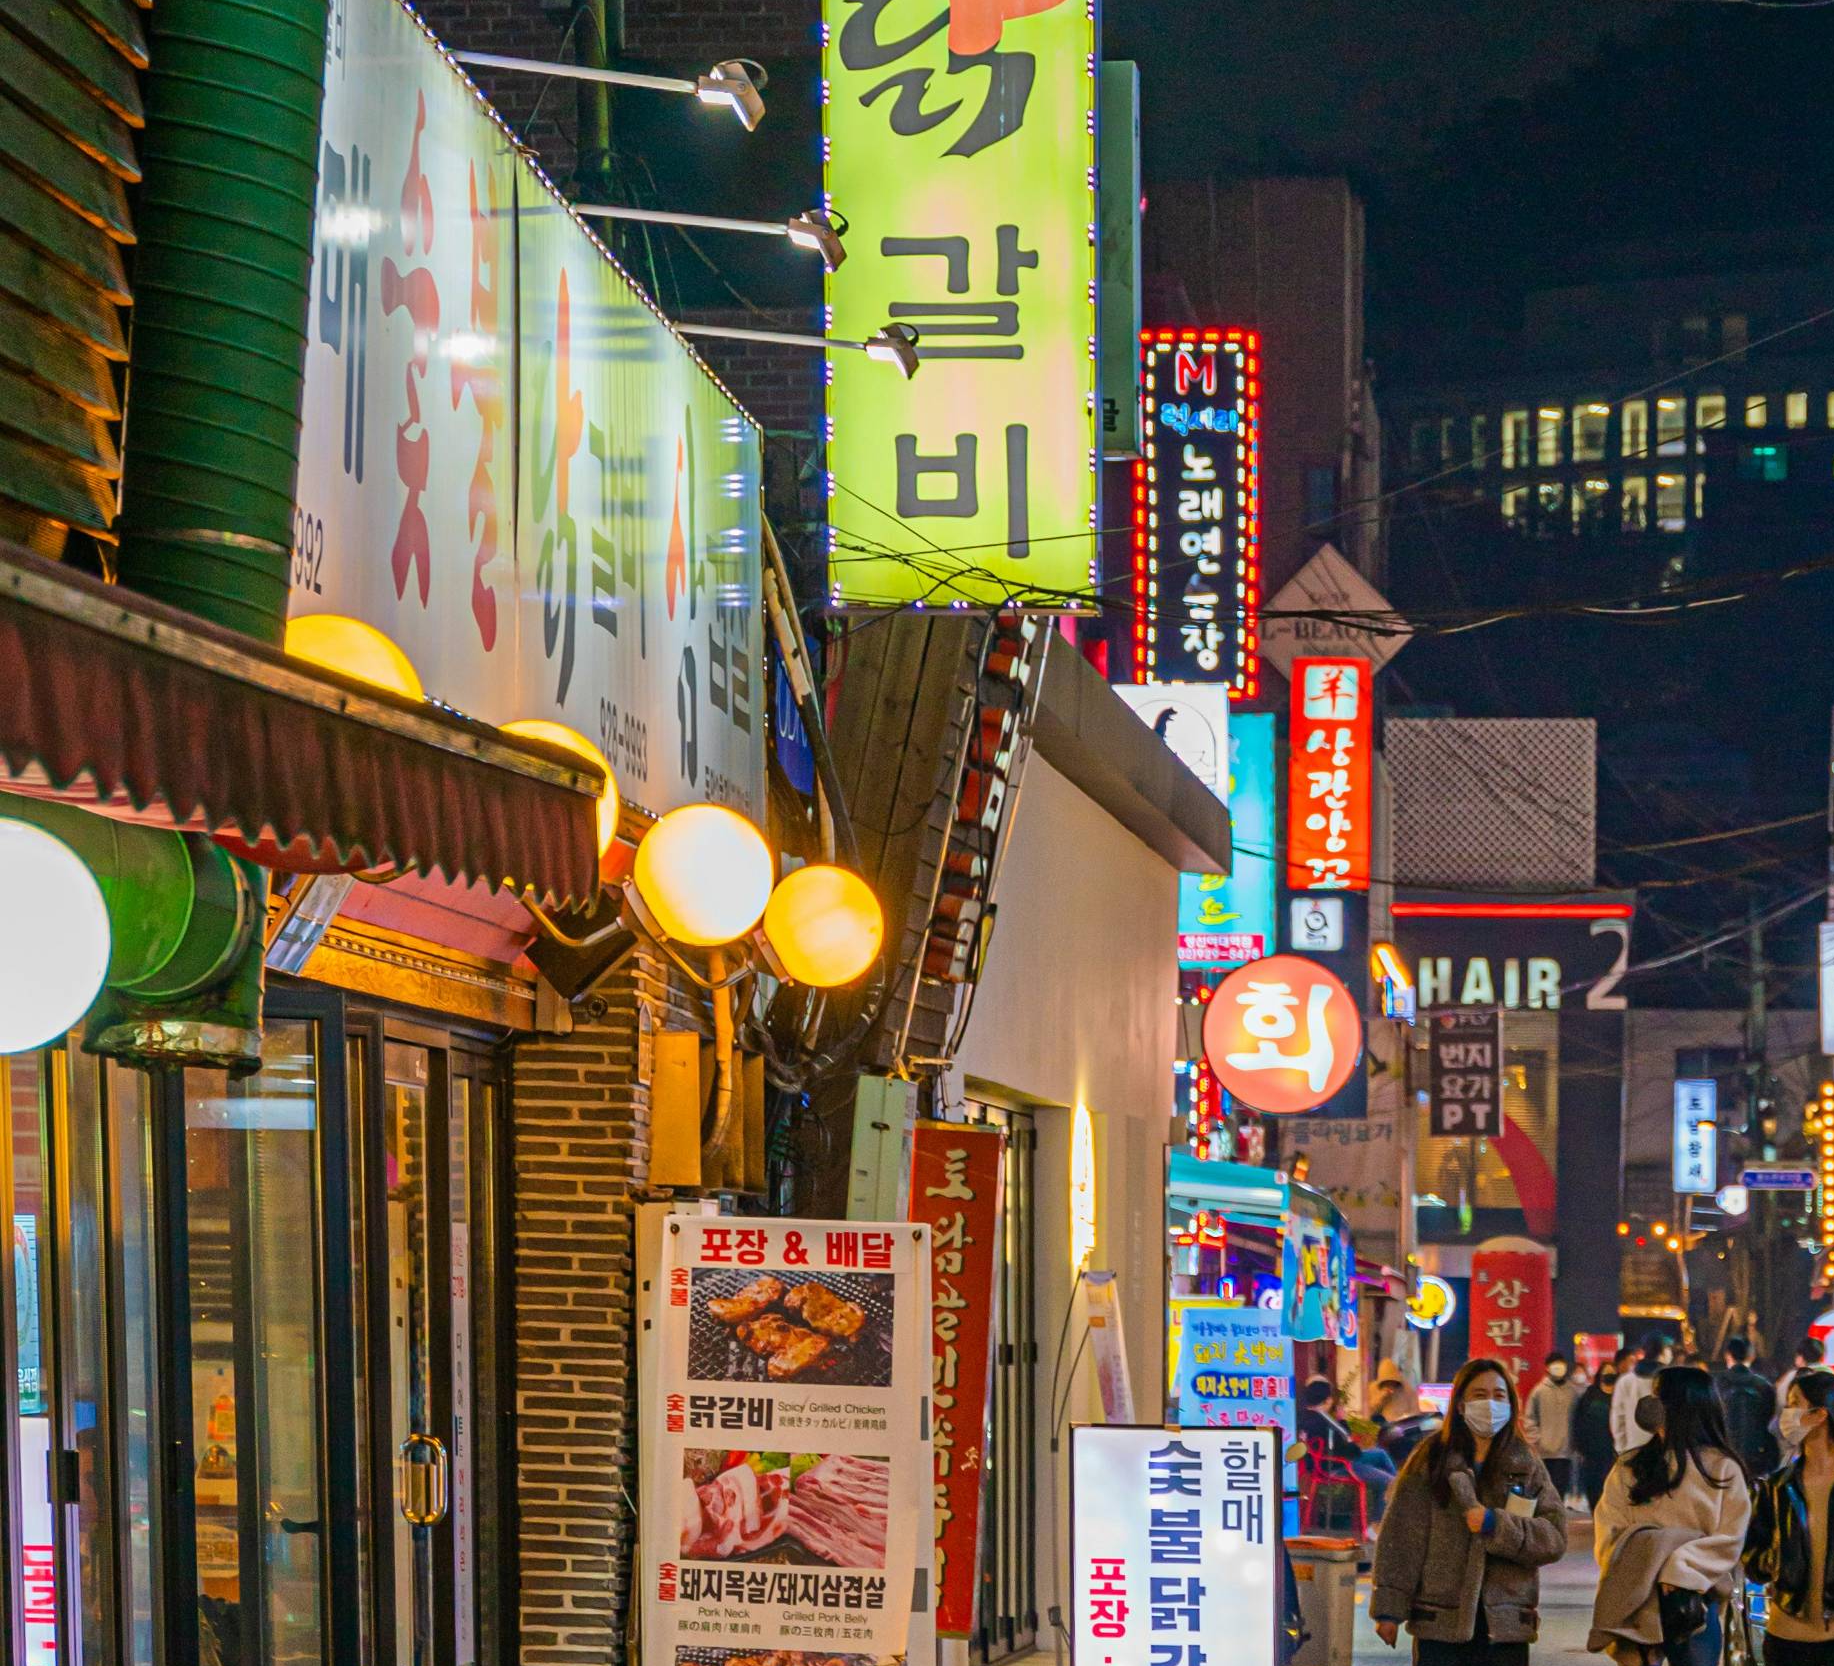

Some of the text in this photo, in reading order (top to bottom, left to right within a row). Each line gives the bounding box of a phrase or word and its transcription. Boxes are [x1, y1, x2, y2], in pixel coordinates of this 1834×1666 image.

[1310, 669, 1353, 717] 羊
[1418, 957, 1562, 1011] HAIR
[1439, 1043, 1493, 1071] 번지
[1440, 1075, 1492, 1100] 요가
[701, 1228, 894, 1268] 포장 & 배달
[689, 1395, 774, 1431] 닭갈비
[778, 1401, 886, 1416] Spicy Grilled Chicken
[1220, 1441, 1267, 1545] 할매
[698, 1606, 868, 1625] Pork Neck Grilled Pork Belly
